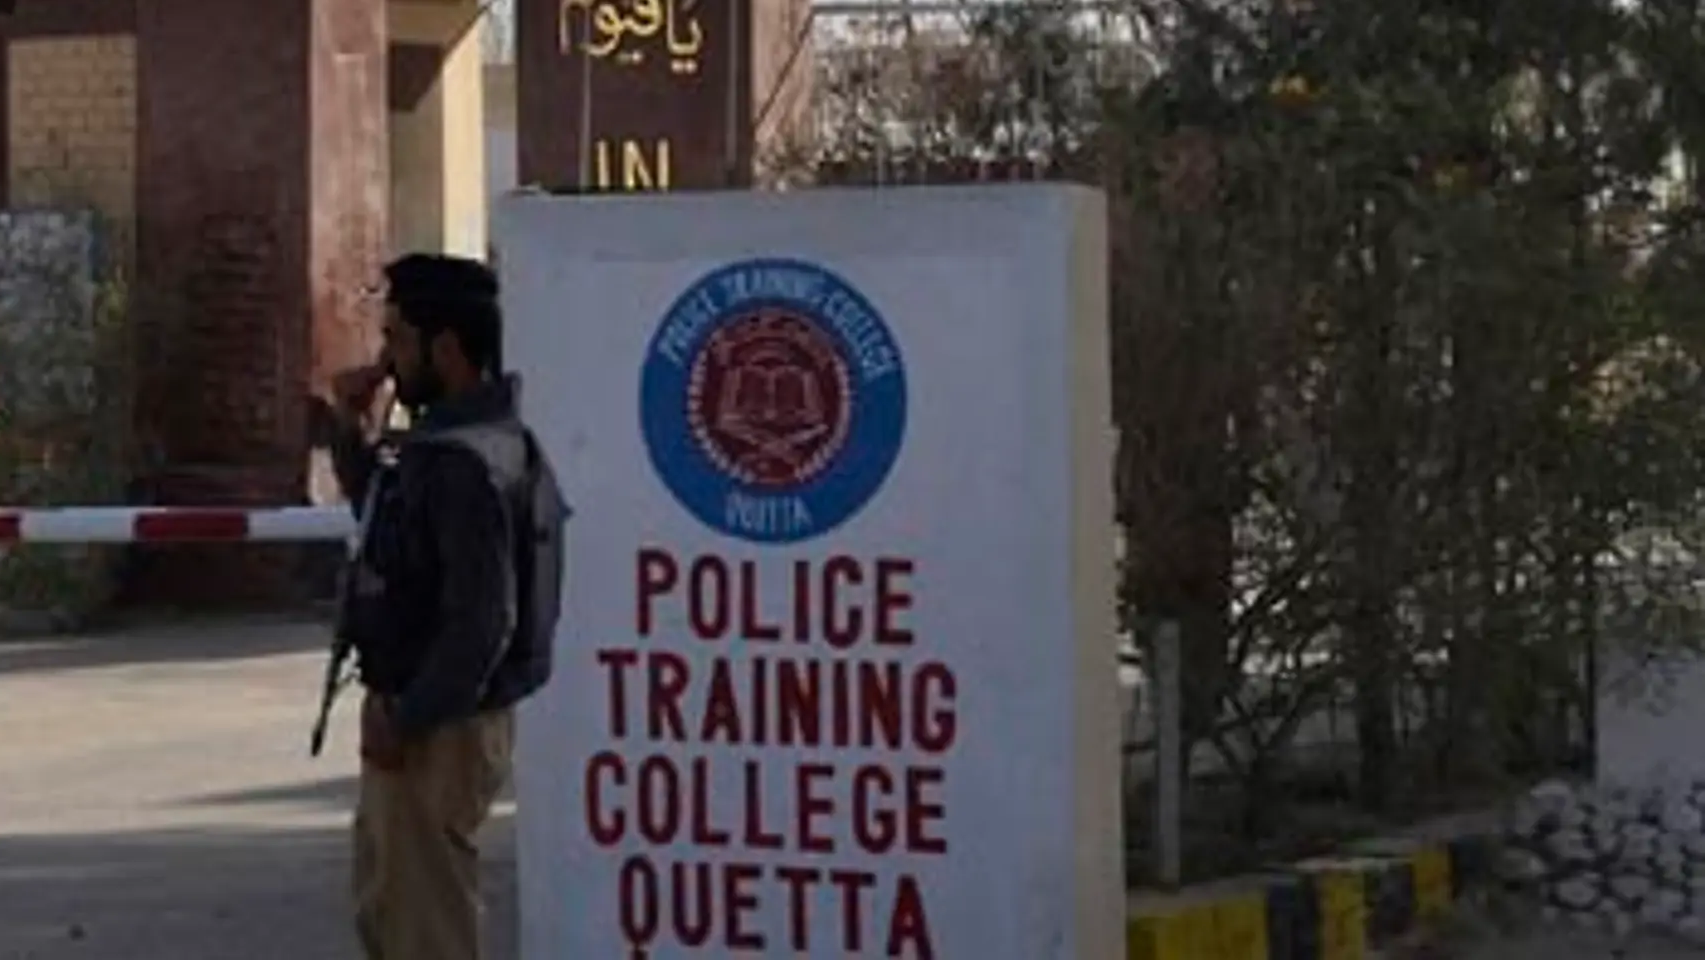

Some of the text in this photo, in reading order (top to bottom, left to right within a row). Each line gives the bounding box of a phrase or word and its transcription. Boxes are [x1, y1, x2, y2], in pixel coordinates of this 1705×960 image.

[596, 139, 670, 190] IN
[637, 548, 915, 646] POLICE
[597, 648, 958, 753] TRAINING
[584, 750, 948, 854] COLLEGE
[618, 853, 935, 959] QUETTA
